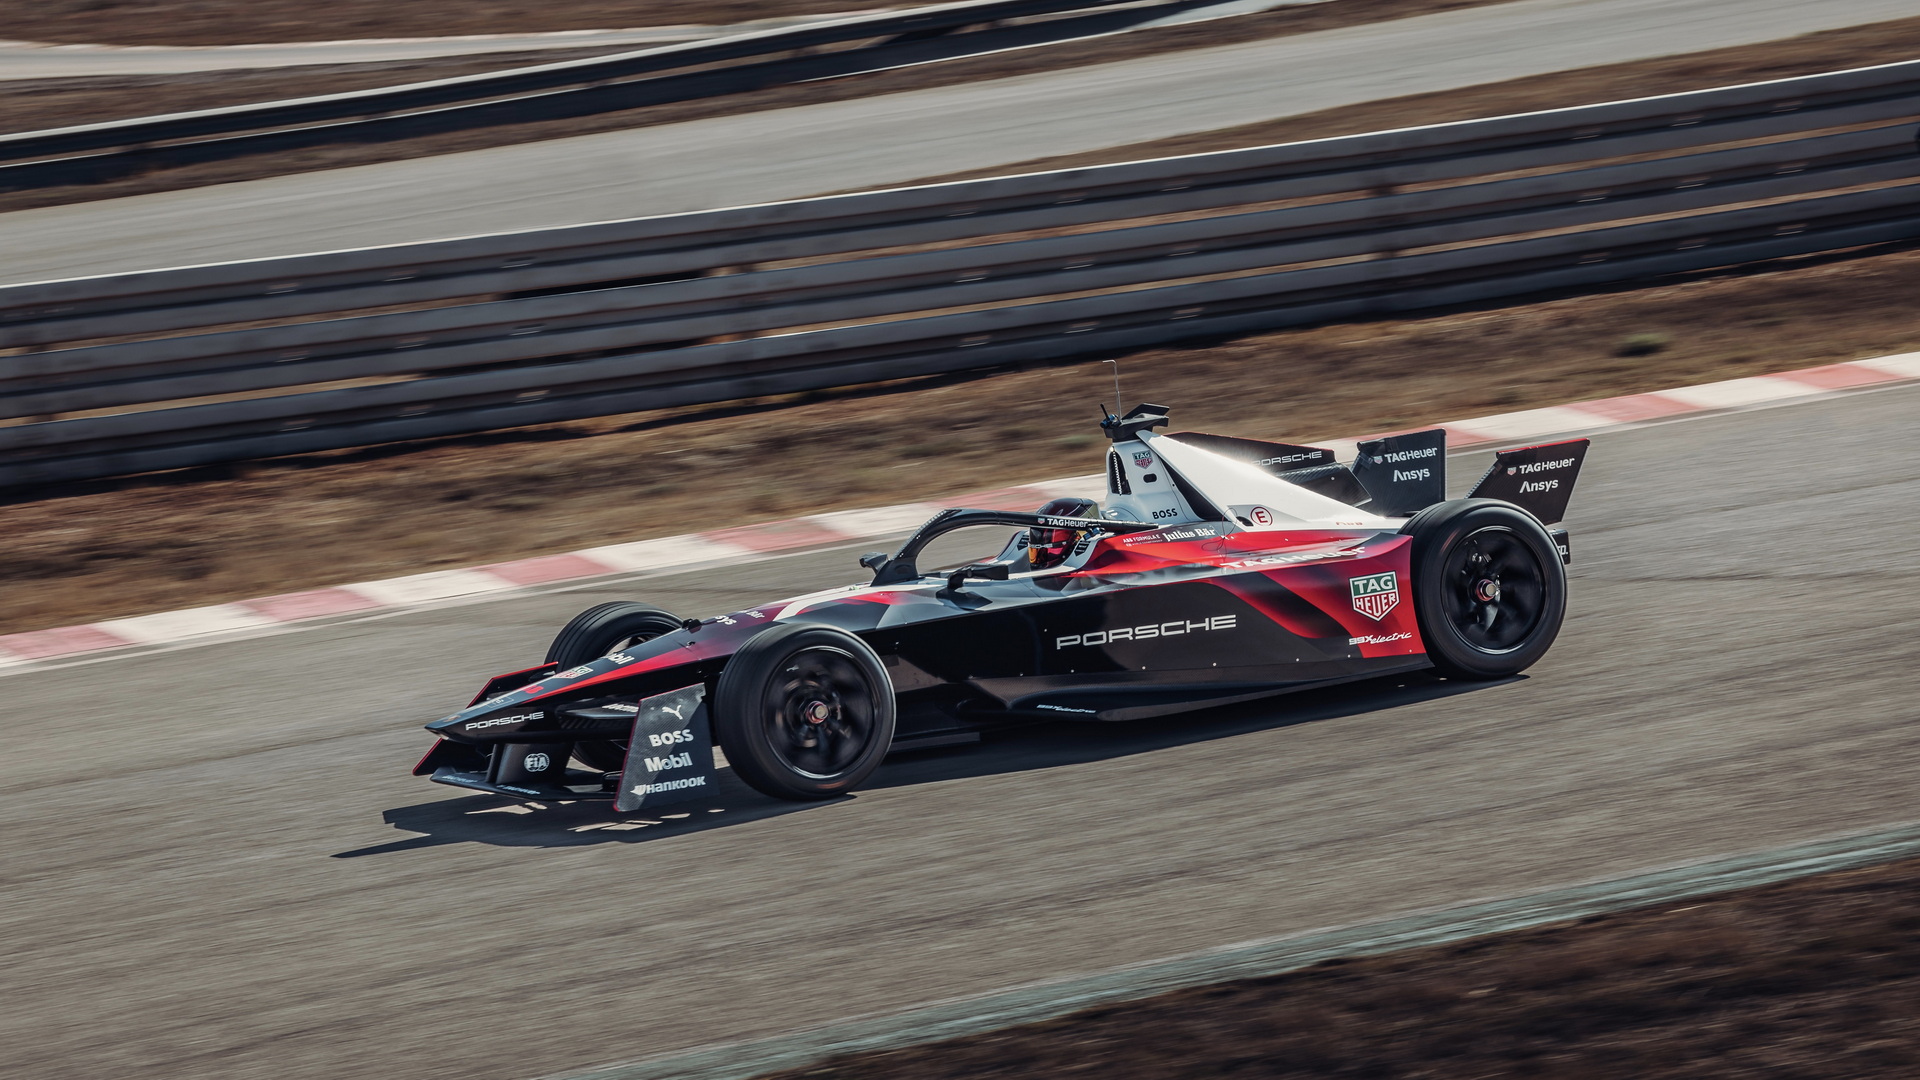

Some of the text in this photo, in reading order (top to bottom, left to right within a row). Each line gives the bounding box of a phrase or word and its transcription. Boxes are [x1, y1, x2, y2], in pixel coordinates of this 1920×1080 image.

[1135, 452, 1151, 460] TAG
[1252, 451, 1322, 466] PORSCHE
[1384, 447, 1437, 463] TAGHeuer
[1519, 457, 1575, 474] TAGHeuer
[1393, 468, 1430, 482] Ansys
[1519, 479, 1558, 493] Ansys
[1152, 508, 1178, 520] BOSS
[1255, 511, 1268, 523] E
[1047, 518, 1088, 528] TAGHeuer
[1162, 530, 1196, 542] Julius
[1194, 527, 1216, 538] Bär
[1354, 576, 1393, 594] TAG
[1356, 592, 1396, 617] HEUER
[1056, 614, 1237, 650] PORSCHE
[465, 711, 545, 731] PORSCHE
[648, 729, 694, 747] BOSS
[526, 756, 547, 768] FIA
[644, 752, 693, 772] Mobil
